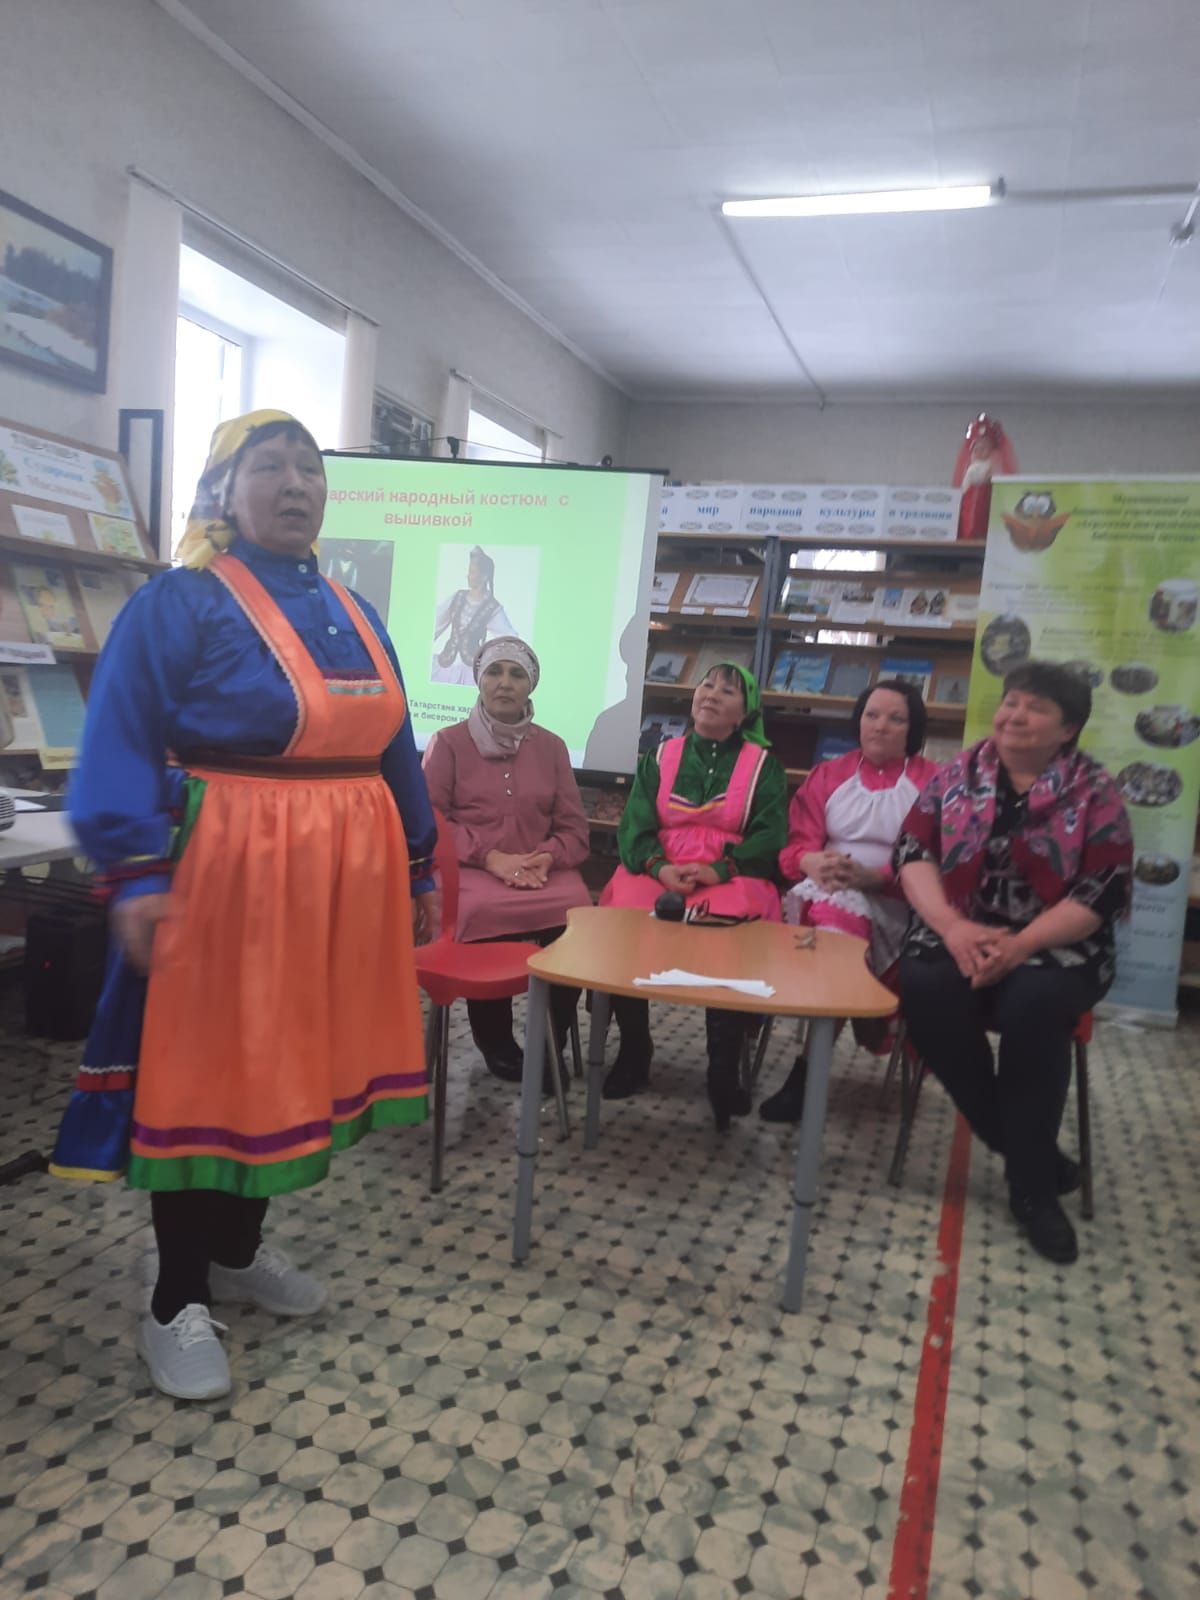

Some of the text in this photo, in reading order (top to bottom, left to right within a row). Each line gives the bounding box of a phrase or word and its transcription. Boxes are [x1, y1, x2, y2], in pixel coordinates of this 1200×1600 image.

[328, 488, 384, 505] арский
[389, 488, 475, 508] народный
[480, 492, 547, 506] костюм
[384, 511, 473, 528] вышивкой
[698, 506, 719, 517] мир
